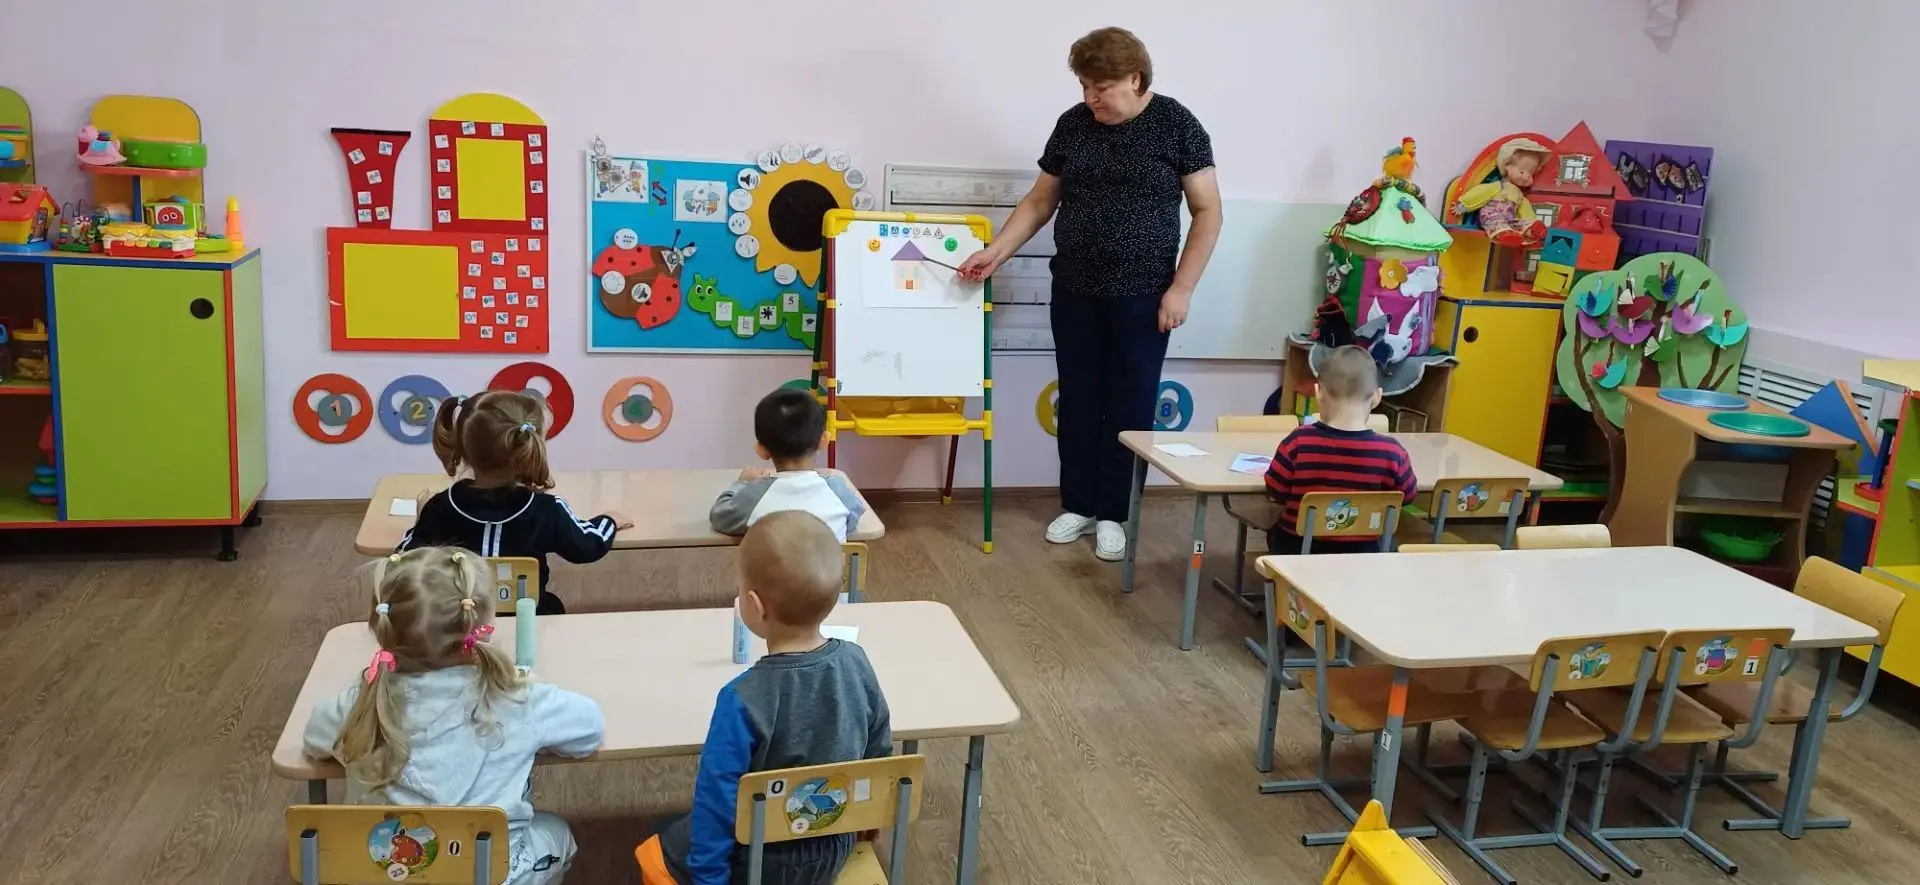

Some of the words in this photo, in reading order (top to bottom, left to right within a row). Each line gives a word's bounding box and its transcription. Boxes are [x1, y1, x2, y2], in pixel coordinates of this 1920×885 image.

[788, 296, 794, 305] 5
[330, 399, 342, 417] 1
[410, 401, 427, 420] 2
[1161, 402, 1172, 418] 8
[1196, 543, 1203, 553] 1
[1746, 661, 1754, 674] 1
[391, 867, 405, 878] 23
